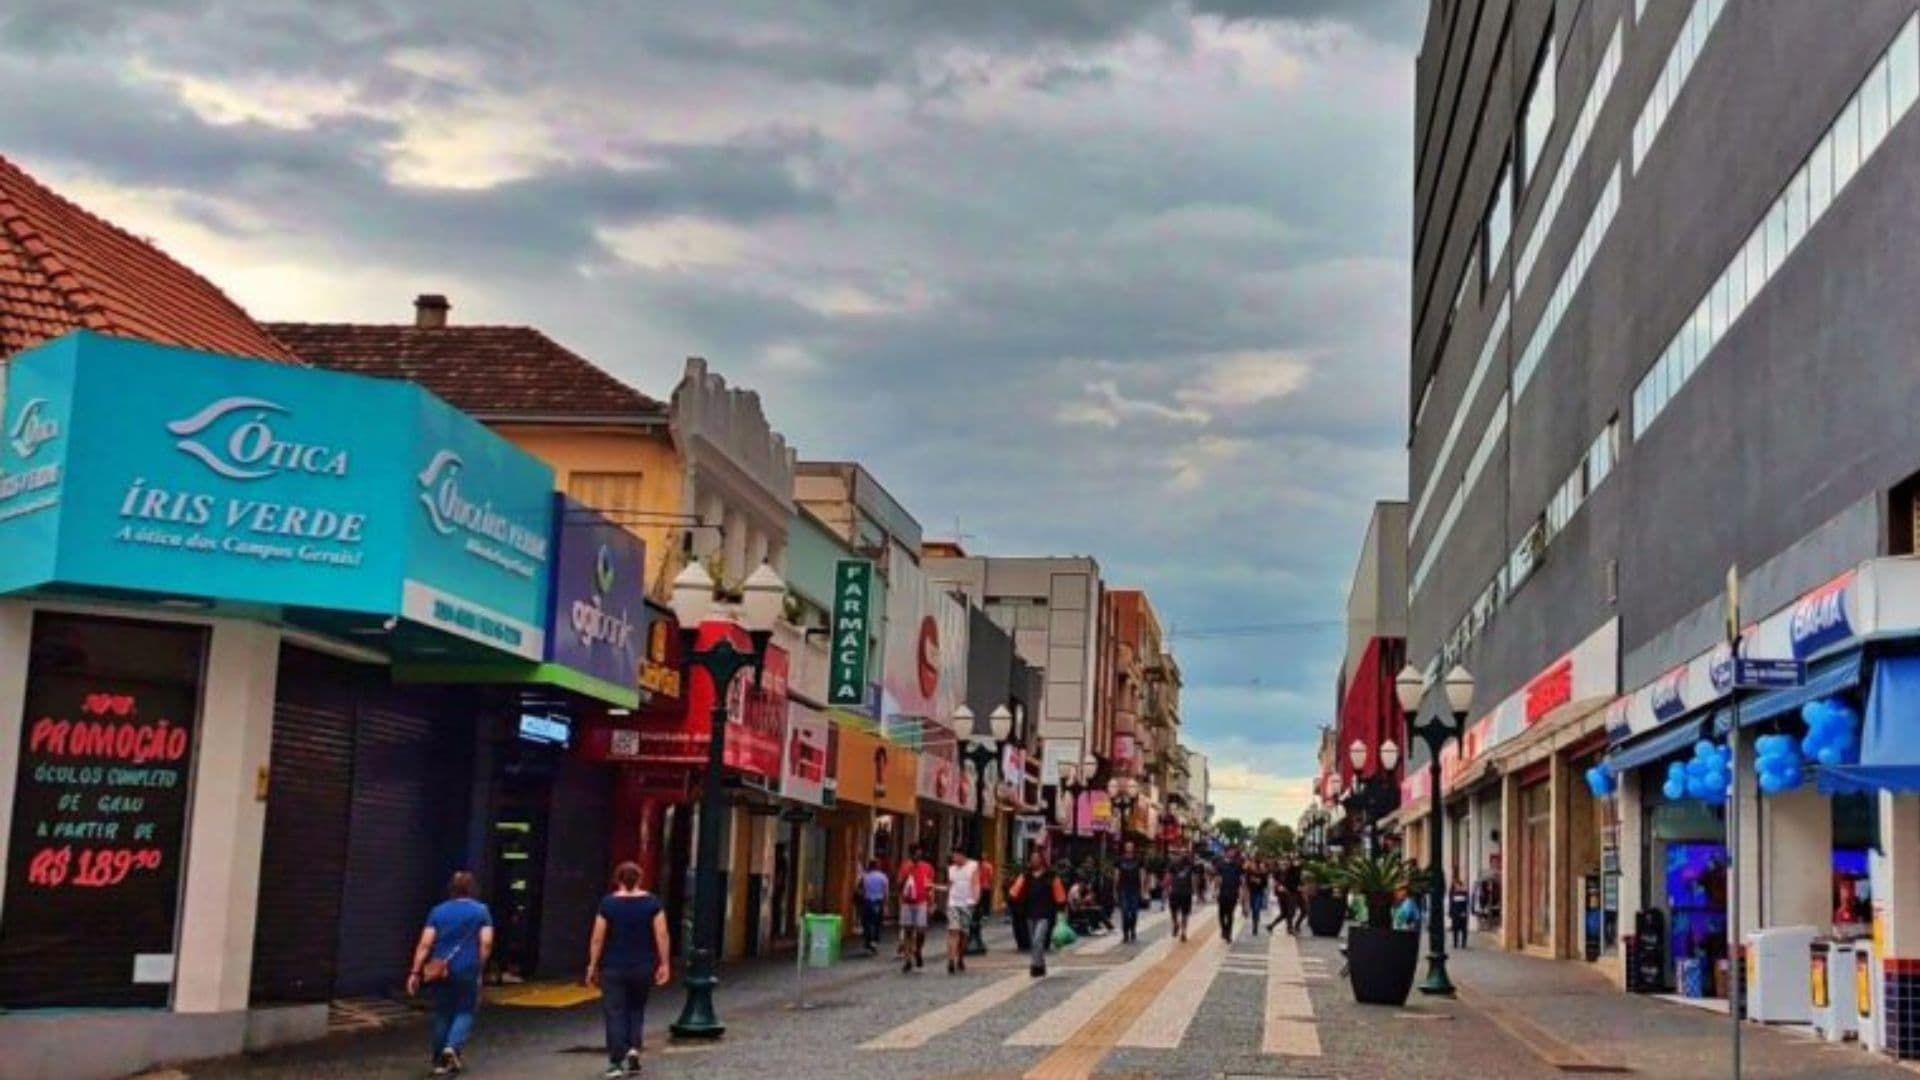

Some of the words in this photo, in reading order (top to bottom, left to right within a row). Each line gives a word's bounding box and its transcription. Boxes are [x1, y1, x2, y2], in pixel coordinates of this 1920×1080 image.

[229, 413, 348, 476] ÓTICA
[119, 477, 214, 526] ÍRIS
[225, 500, 366, 543] VERDE
[30, 717, 188, 764] PROMOÇÃO
[34, 760, 103, 785] ÓCULOS
[107, 768, 178, 788] COMPLETO
[57, 793, 82, 812] DE
[97, 795, 144, 814] GRAU
[53, 822, 120, 840] PARTIR
[133, 821, 156, 839] DE
[28, 845, 72, 888] R$
